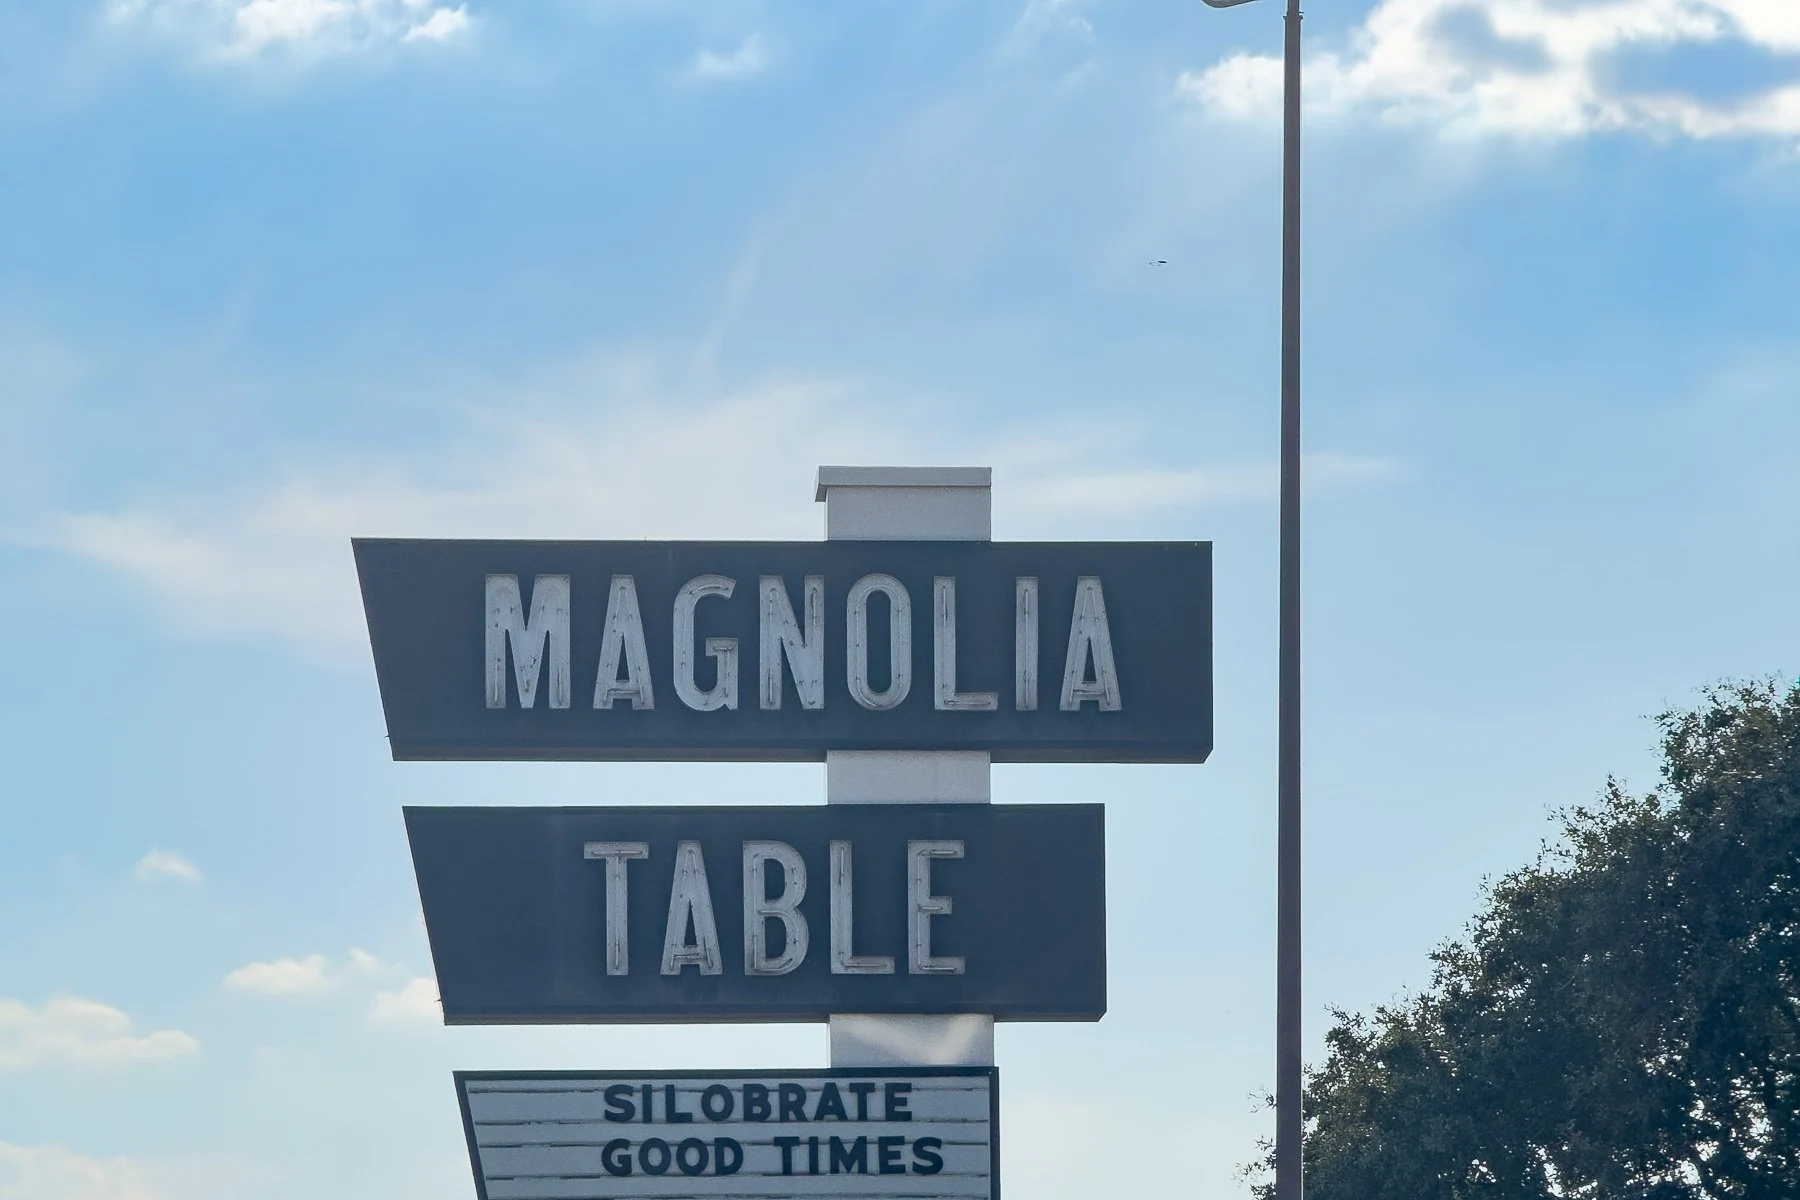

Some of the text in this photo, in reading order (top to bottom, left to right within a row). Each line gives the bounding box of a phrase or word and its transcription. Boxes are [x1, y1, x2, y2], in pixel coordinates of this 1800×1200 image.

[484, 573, 1122, 711] MAGNOLIA
[583, 839, 965, 976] TABLE
[603, 1082, 913, 1123] SILOBRATE
[601, 1135, 944, 1177] GOOD TIMES
